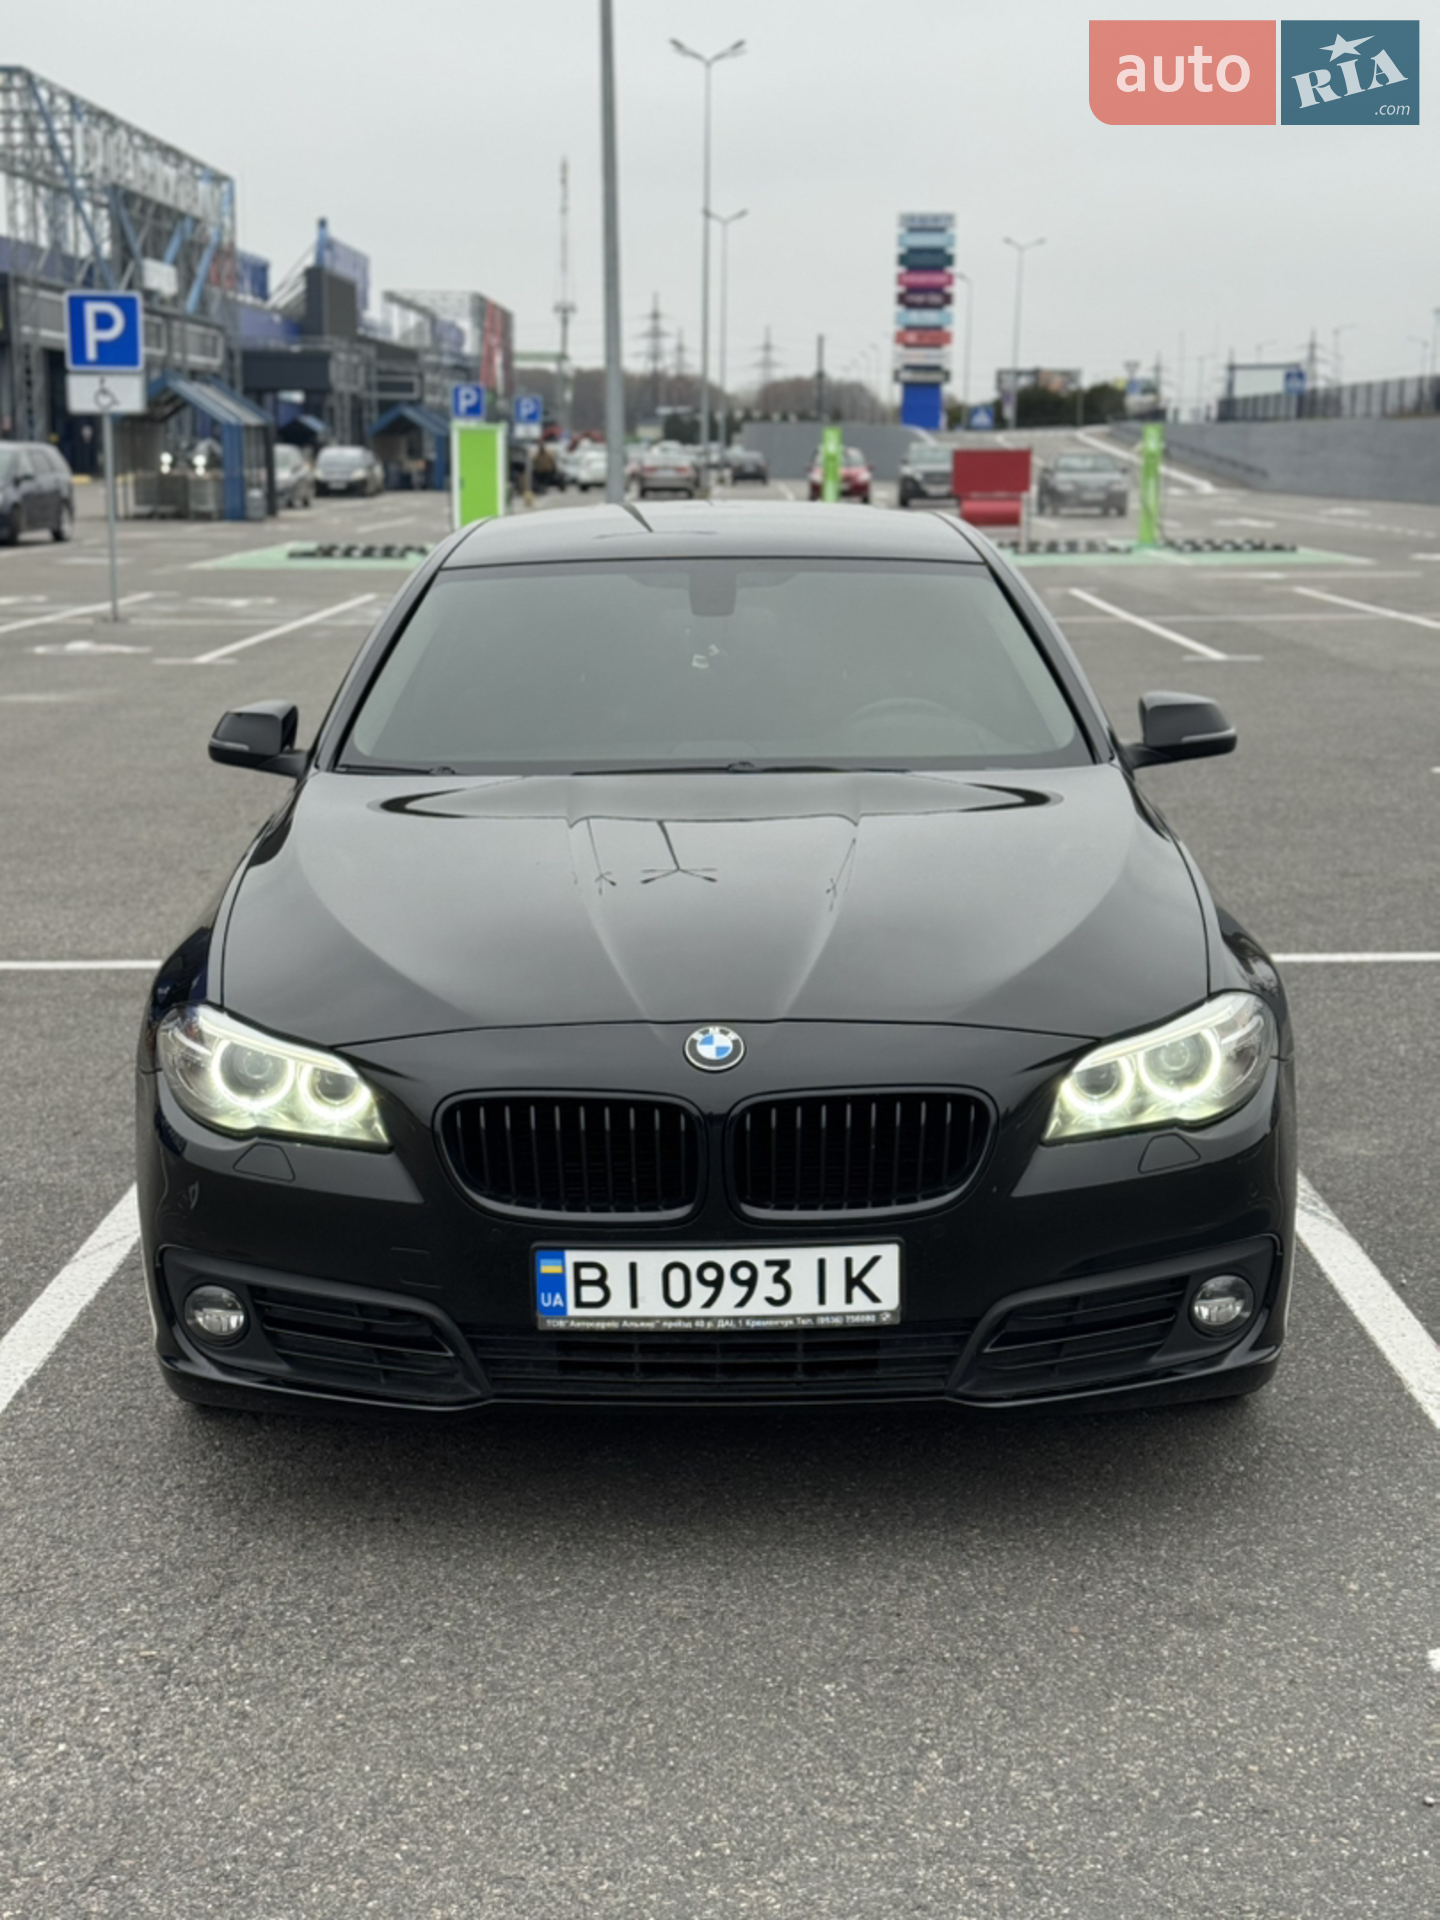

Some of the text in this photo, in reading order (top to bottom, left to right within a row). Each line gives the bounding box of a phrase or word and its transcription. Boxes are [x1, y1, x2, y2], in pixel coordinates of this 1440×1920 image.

[83, 301, 126, 362] P
[458, 386, 479, 416] P
[520, 398, 537, 421] P
[661, 1259, 792, 1309] 0993
[540, 1292, 565, 1308] UA
